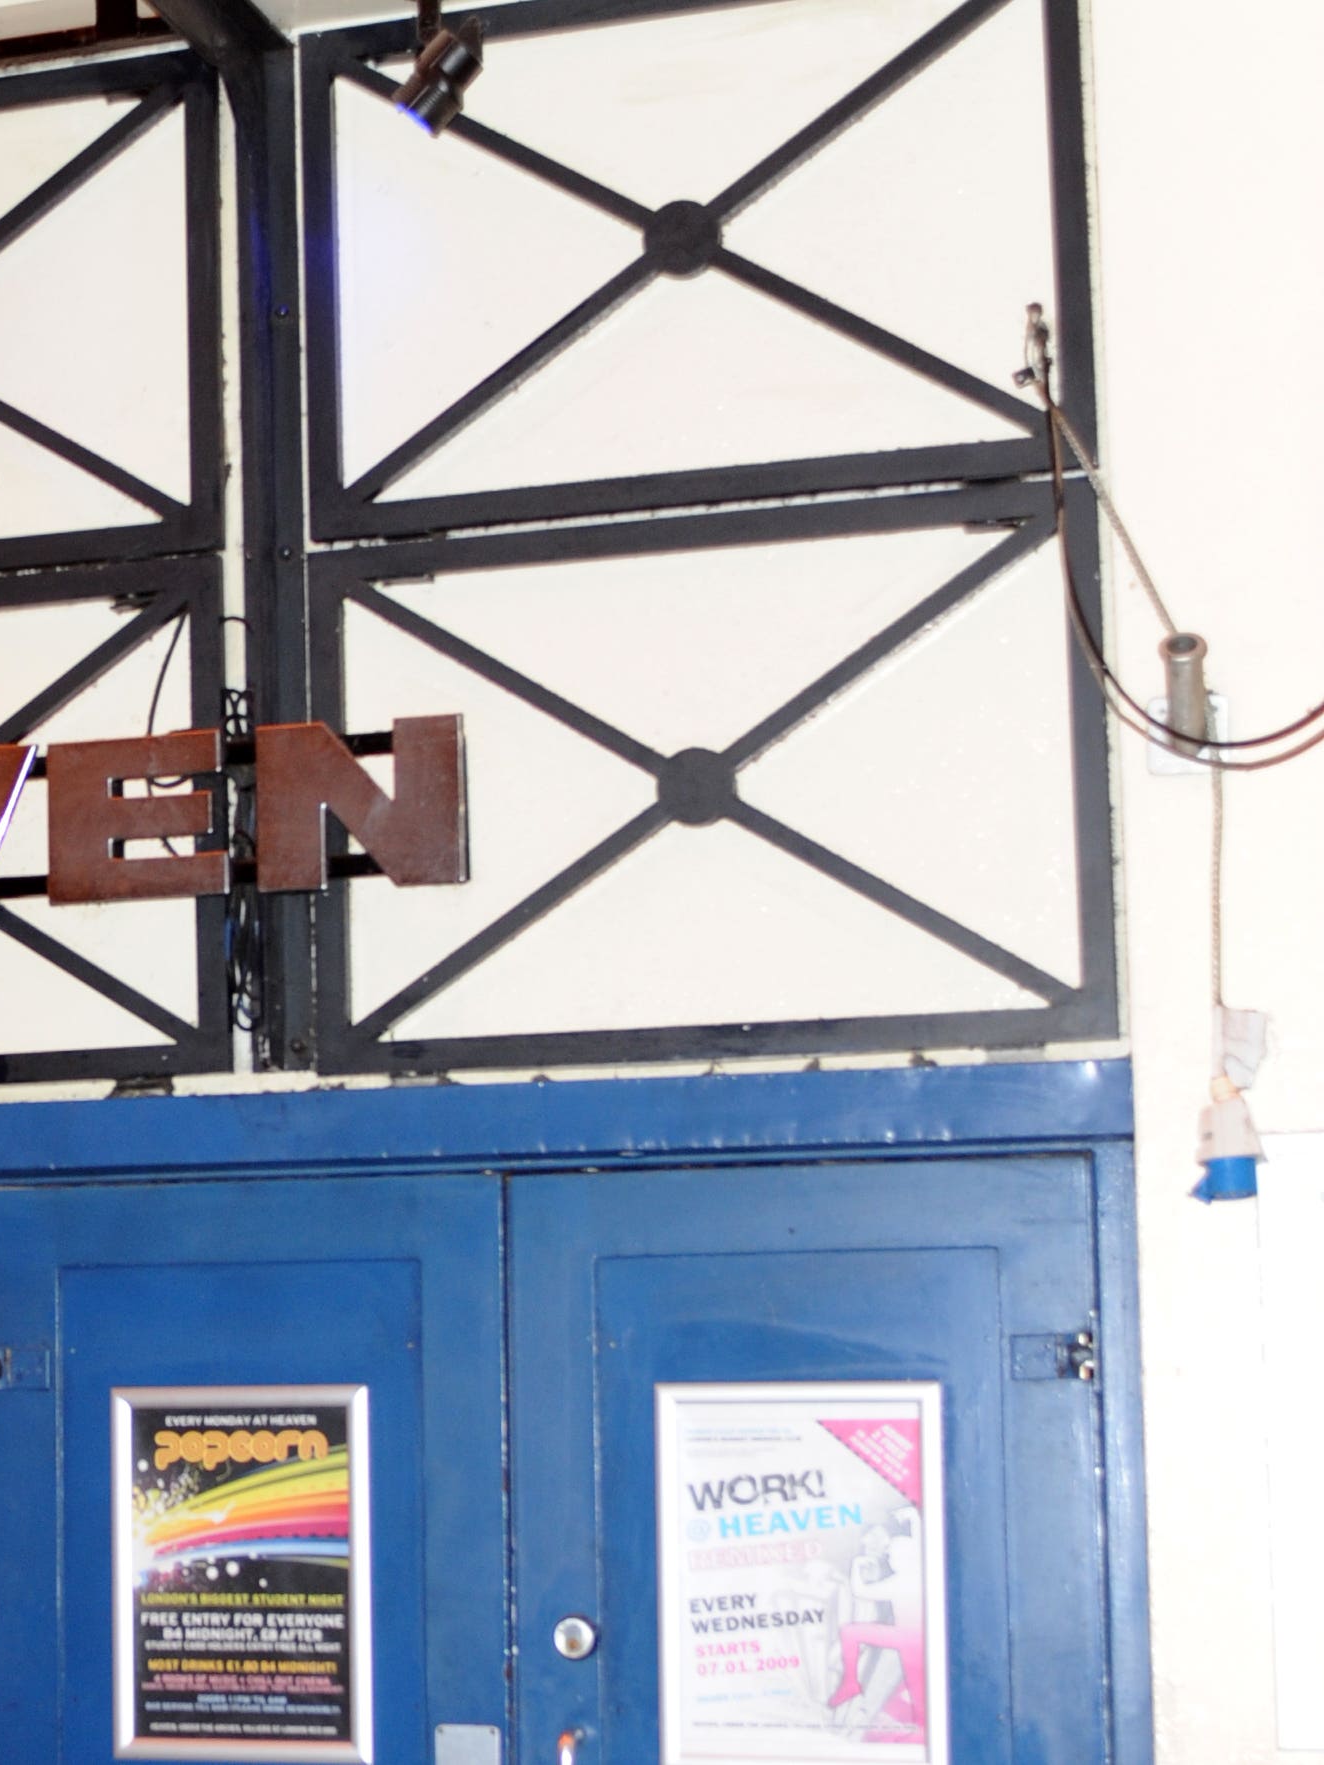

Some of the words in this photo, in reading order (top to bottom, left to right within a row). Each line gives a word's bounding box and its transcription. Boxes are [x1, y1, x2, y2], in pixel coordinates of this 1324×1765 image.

[165, 1415, 202, 1427] EVERY
[203, 1415, 251, 1427] MONDAY
[253, 1415, 268, 1427] AT
[269, 1414, 317, 1426] HEAVEN
[154, 1429, 329, 1471] popcorn
[687, 1470, 826, 1511] WORK!
[718, 1503, 863, 1539] HEAVEN
[141, 1592, 199, 1606] LONDON'S
[200, 1593, 250, 1606] BIGGEST
[252, 1593, 306, 1607] STUDENT
[307, 1594, 344, 1607] NIGHT
[689, 1593, 756, 1614] EVERY
[140, 1612, 179, 1626] FREE
[181, 1612, 231, 1626] ENTRY
[233, 1612, 264, 1627] FOR
[266, 1613, 345, 1628] EVERYONE
[691, 1608, 824, 1634] WEDNESDAY
[162, 1626, 183, 1640] B4
[279, 1628, 324, 1642] AFTER
[695, 1639, 761, 1658] STARTS
[147, 1658, 179, 1672] MOST
[181, 1659, 224, 1673] DRINKS
